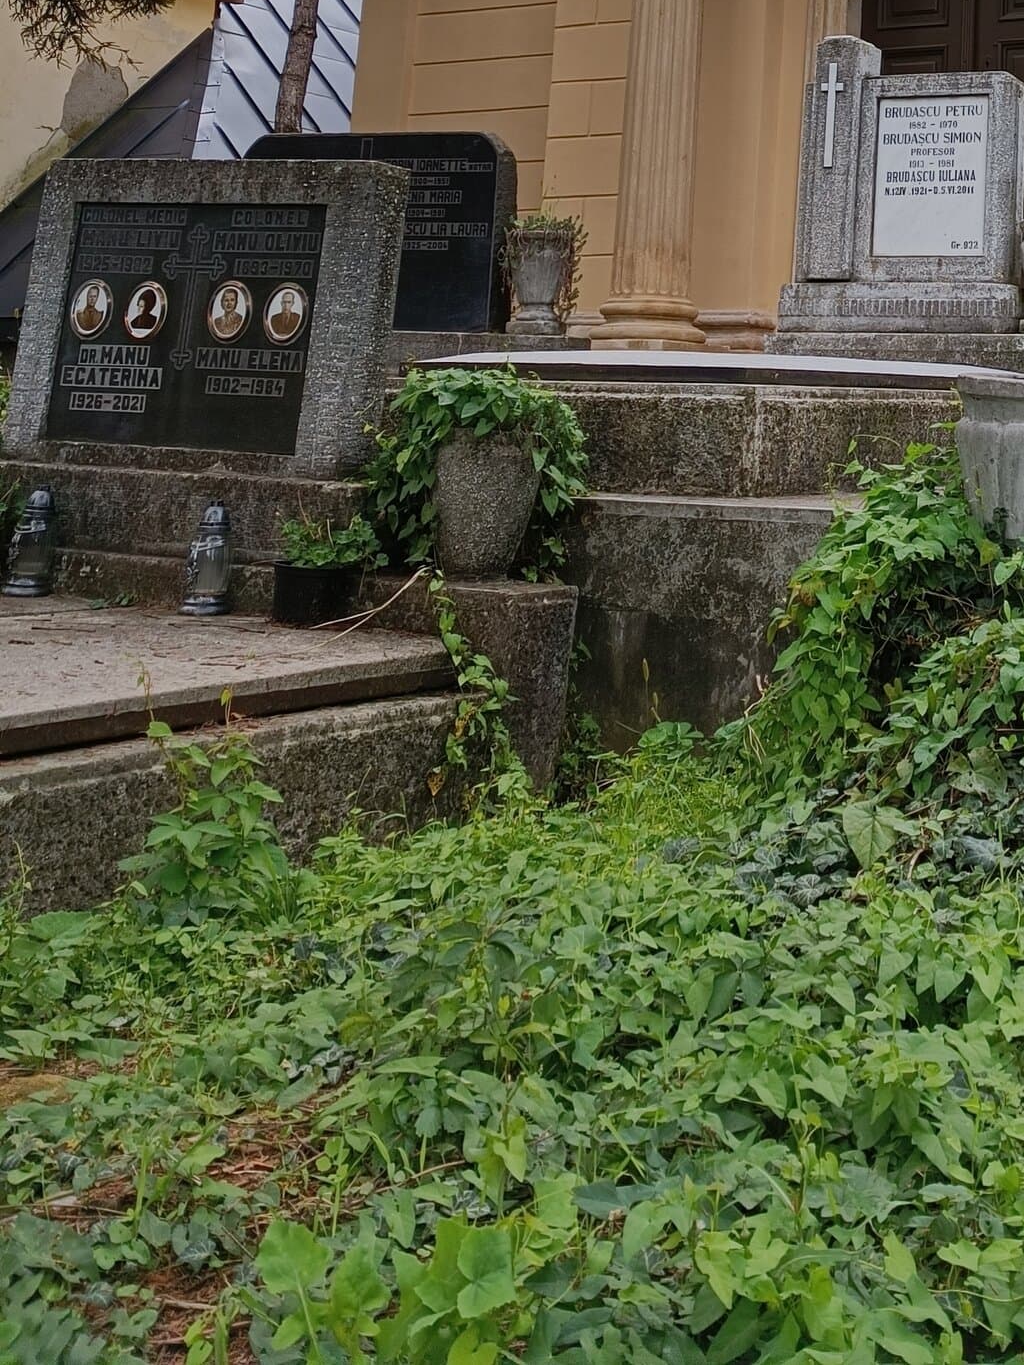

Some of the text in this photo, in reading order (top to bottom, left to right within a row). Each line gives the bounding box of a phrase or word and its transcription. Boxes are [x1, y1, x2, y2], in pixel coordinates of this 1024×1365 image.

[945, 105, 983, 117] PETRU
[943, 132, 982, 143] SIMION
[910, 148, 956, 156] PROFESOR
[938, 159, 955, 168] 1981
[939, 170, 976, 182] IULIANA
[429, 190, 460, 202] MARIA
[84, 209, 185, 224] COLONEL MEDIC
[451, 224, 487, 236] LAURA
[214, 233, 258, 251] MANU
[100, 346, 149, 365] MANU
[197, 348, 302, 371] MANU ELENA
[61, 367, 160, 387] ECATERINA
[71, 393, 145, 411] 1926-2021
